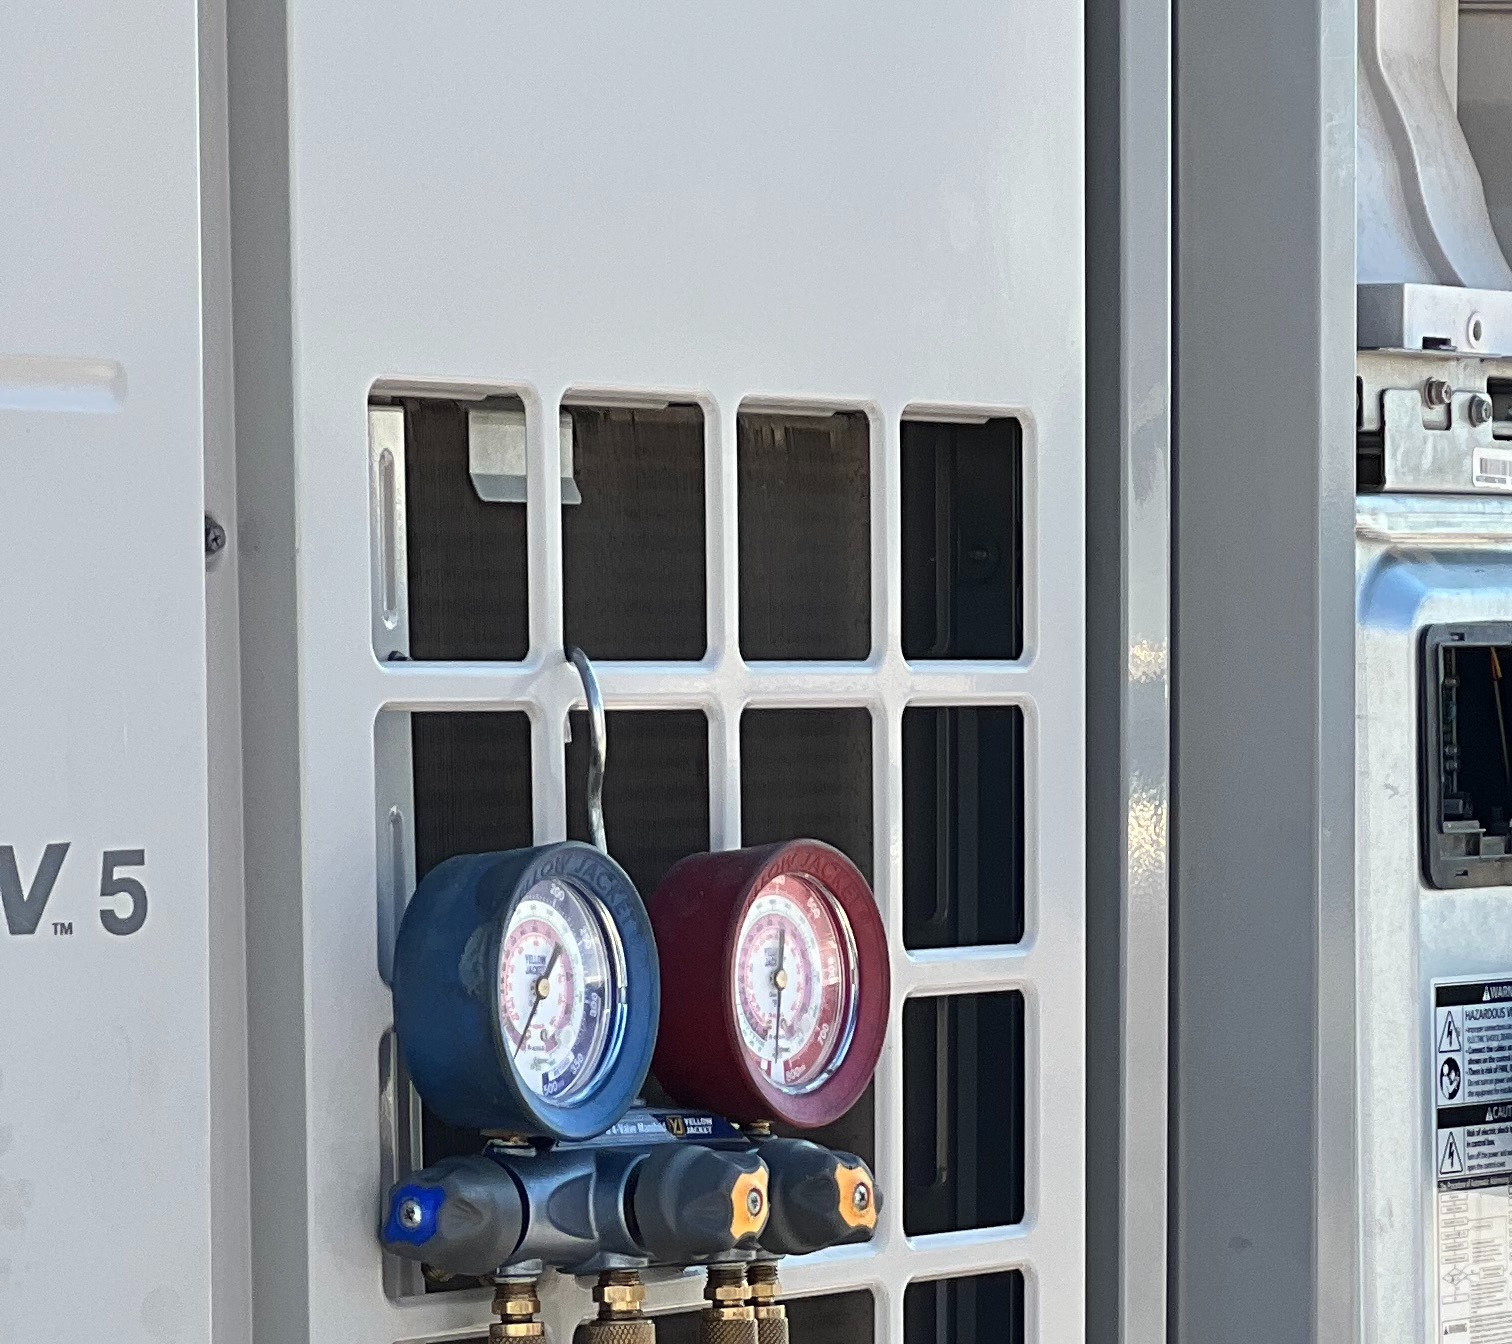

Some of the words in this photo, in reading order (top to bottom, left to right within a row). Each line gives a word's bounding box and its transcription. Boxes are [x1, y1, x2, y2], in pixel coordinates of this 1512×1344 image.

[99, 848, 149, 936] 5
[1465, 1006, 1506, 1021] HAZARDOUS
[684, 1117, 713, 1126] YELLOW
